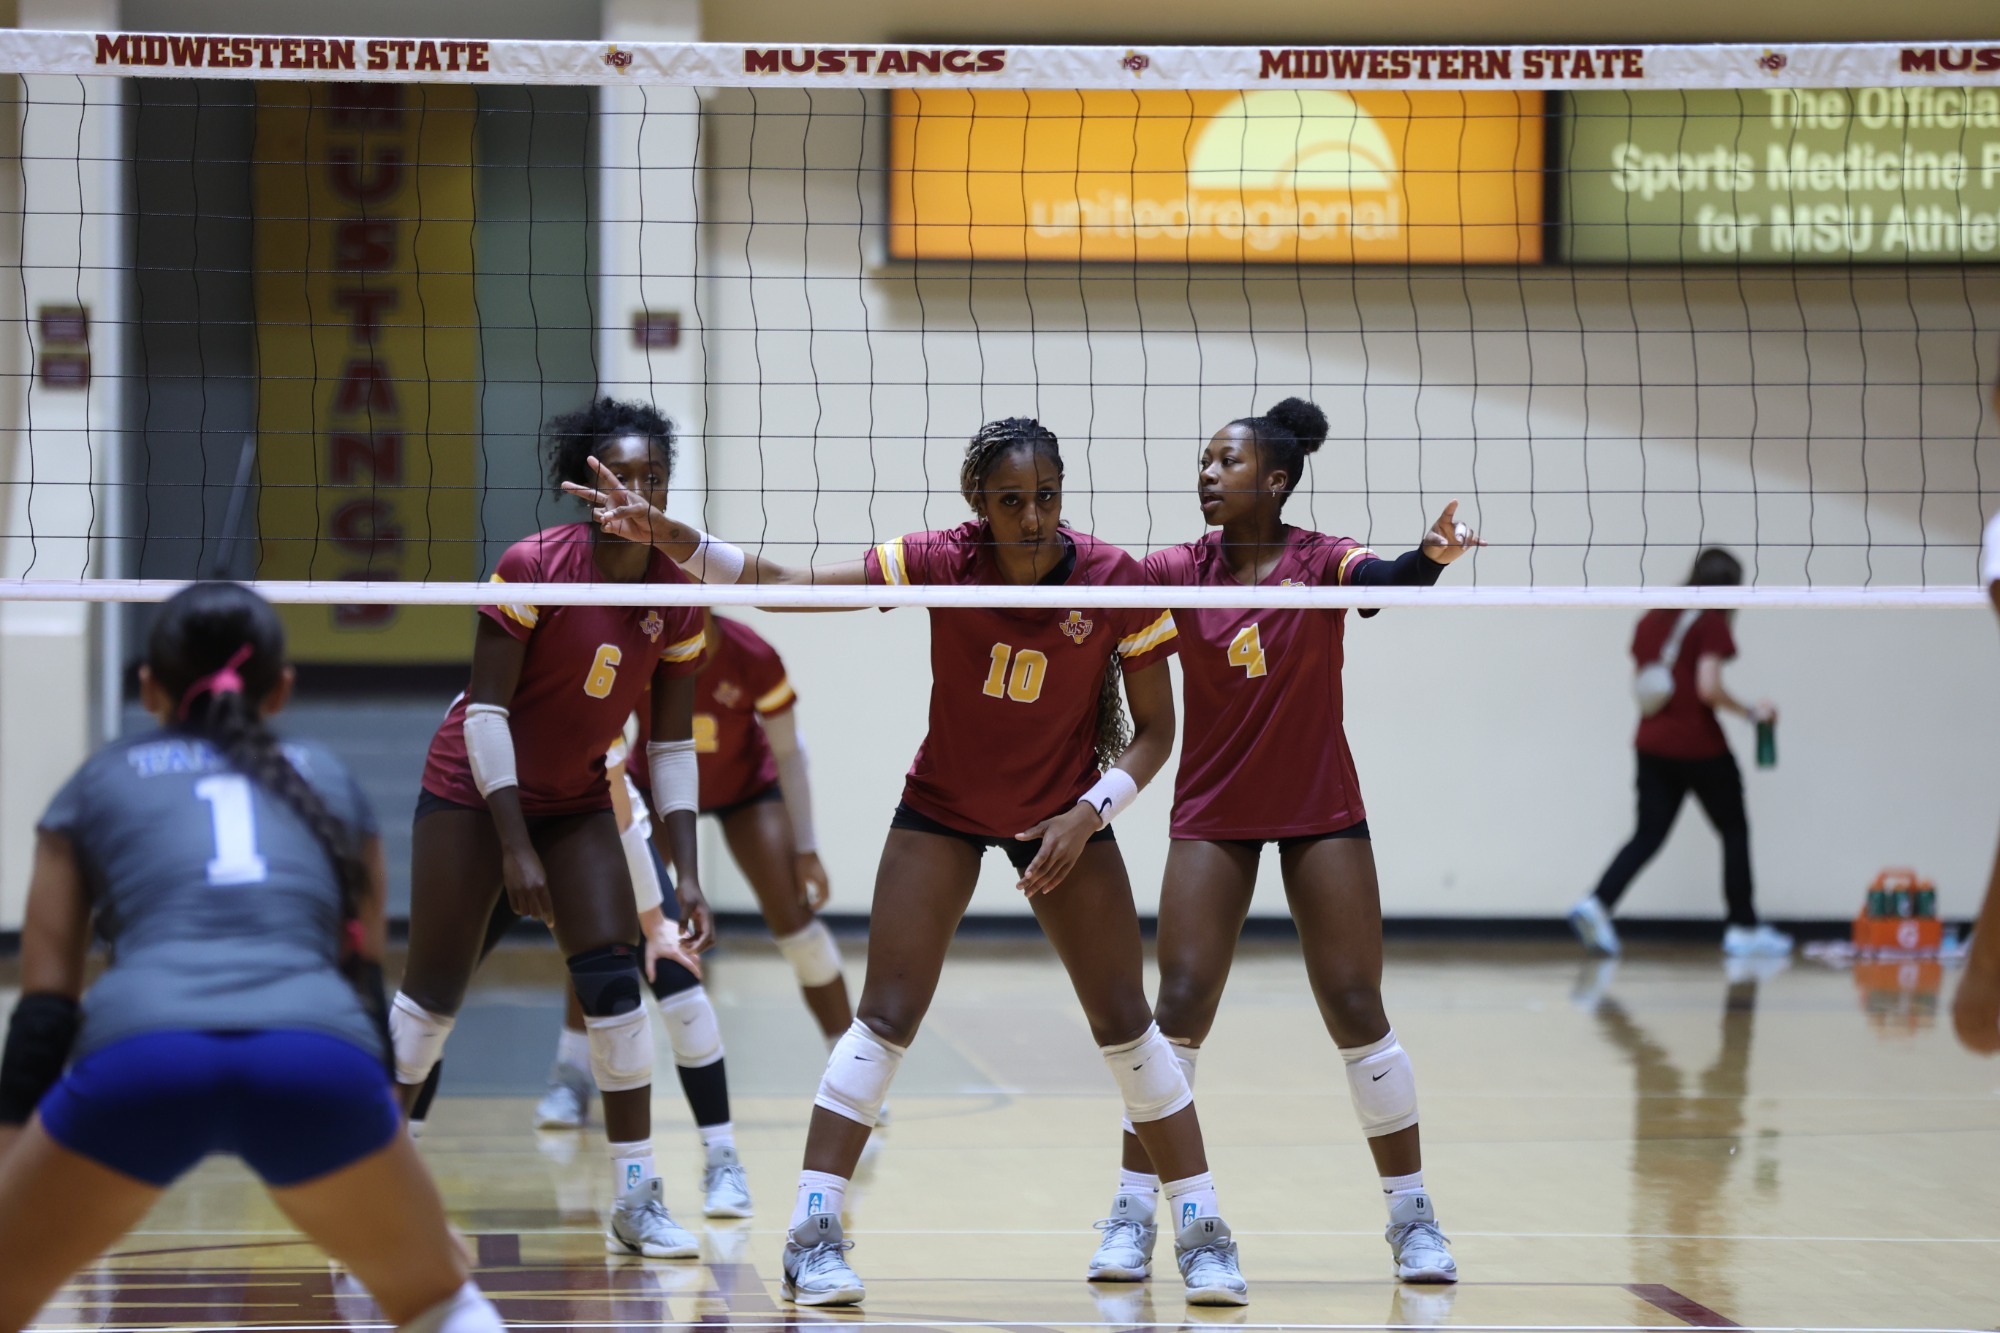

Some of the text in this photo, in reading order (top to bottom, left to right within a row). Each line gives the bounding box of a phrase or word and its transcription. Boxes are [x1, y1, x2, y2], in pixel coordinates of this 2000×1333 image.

[95, 33, 490, 72] MIDWESTERN STATE
[744, 48, 1006, 75] MUSTANGS
[1259, 48, 1643, 79] MIDWESTERN STATE
[1900, 48, 2000, 73] MUS
[1766, 87, 1845, 129] The
[1610, 143, 1755, 200] Sports
[1766, 142, 1968, 191] Medicine
[1698, 203, 2000, 253] for MSU Athle
[584, 644, 622, 699] 6
[983, 642, 1048, 703] 10
[1227, 622, 1267, 678] 4
[195, 774, 266, 886] 1
